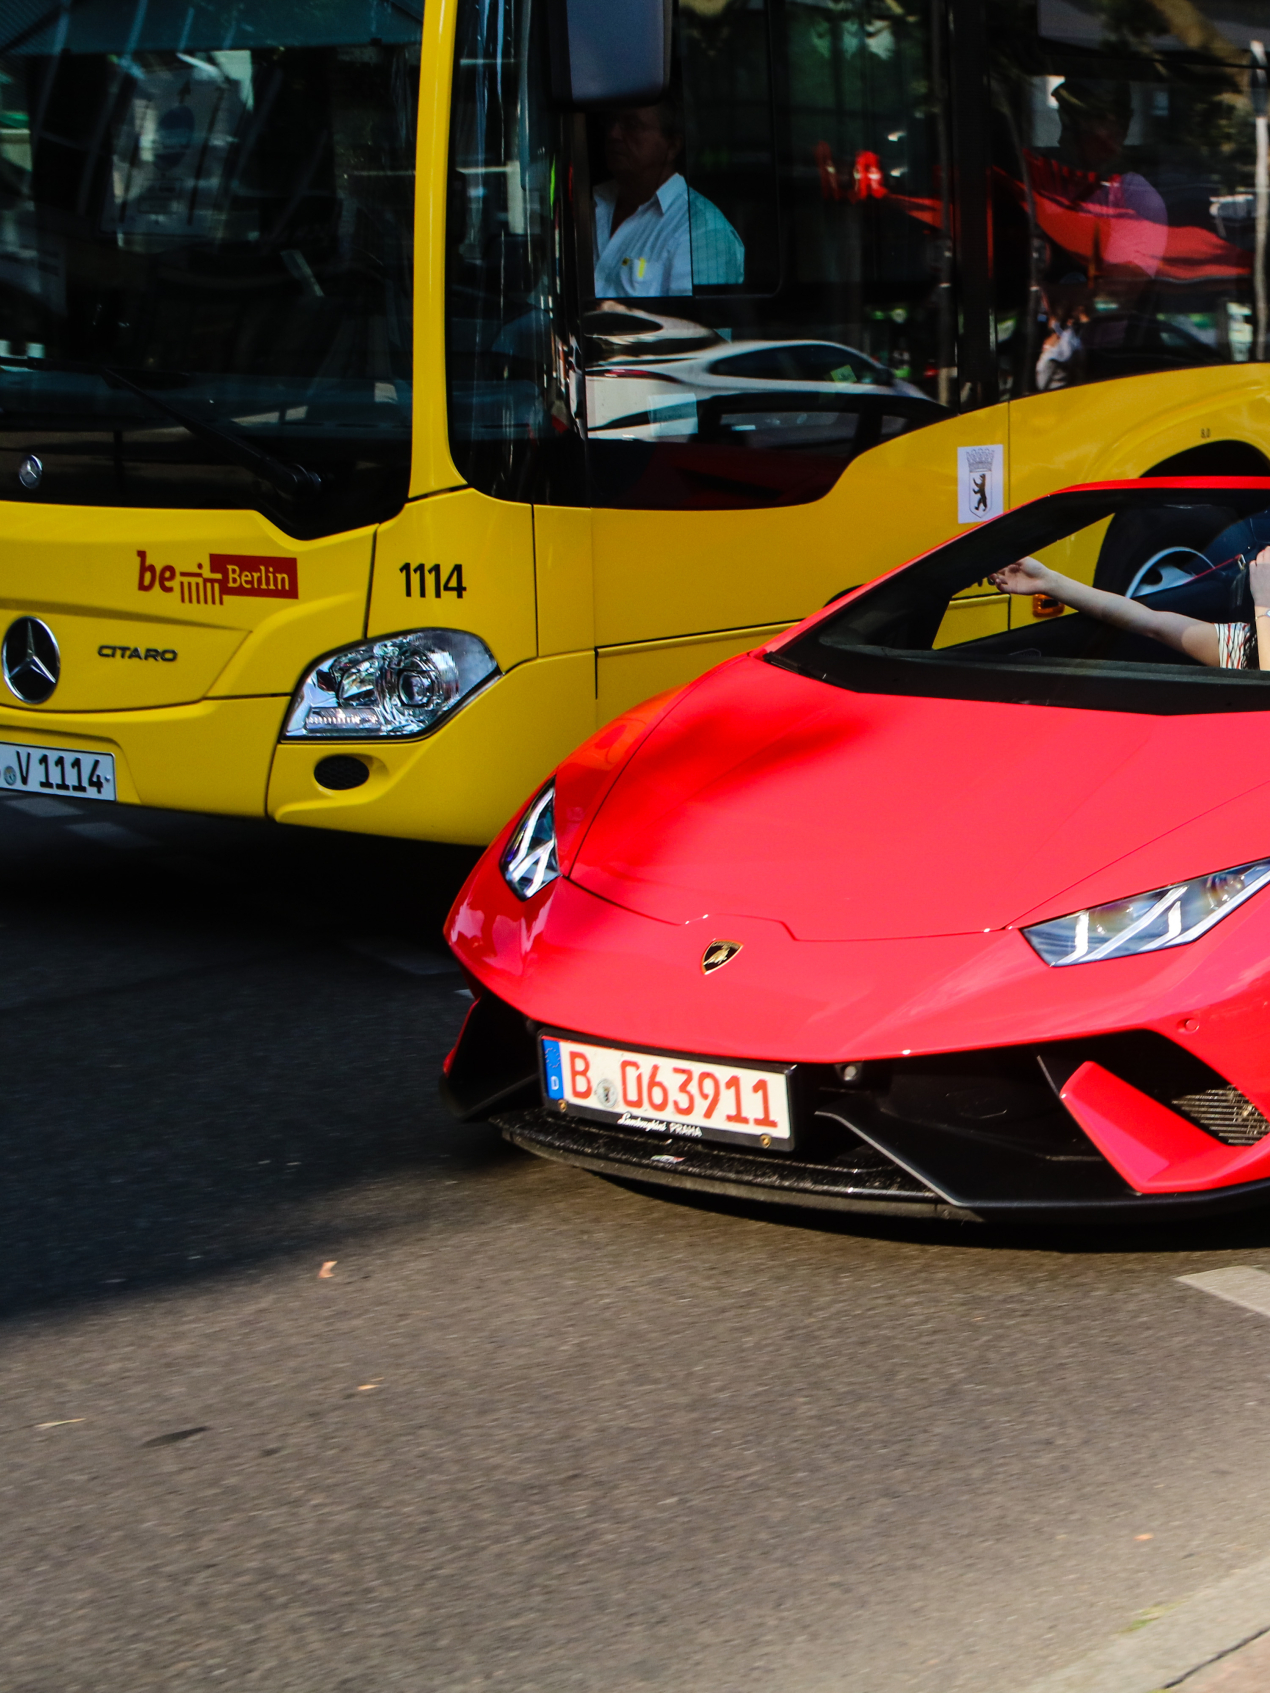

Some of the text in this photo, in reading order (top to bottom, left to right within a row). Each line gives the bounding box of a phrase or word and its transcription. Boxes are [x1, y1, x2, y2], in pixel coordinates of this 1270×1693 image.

[136, 549, 290, 593] be Berlin
[398, 562, 468, 600] 1114
[97, 644, 178, 662] CITARO
[15, 750, 104, 795] V 1114
[550, 1075, 559, 1091] D
[569, 1050, 778, 1128] B 063911
